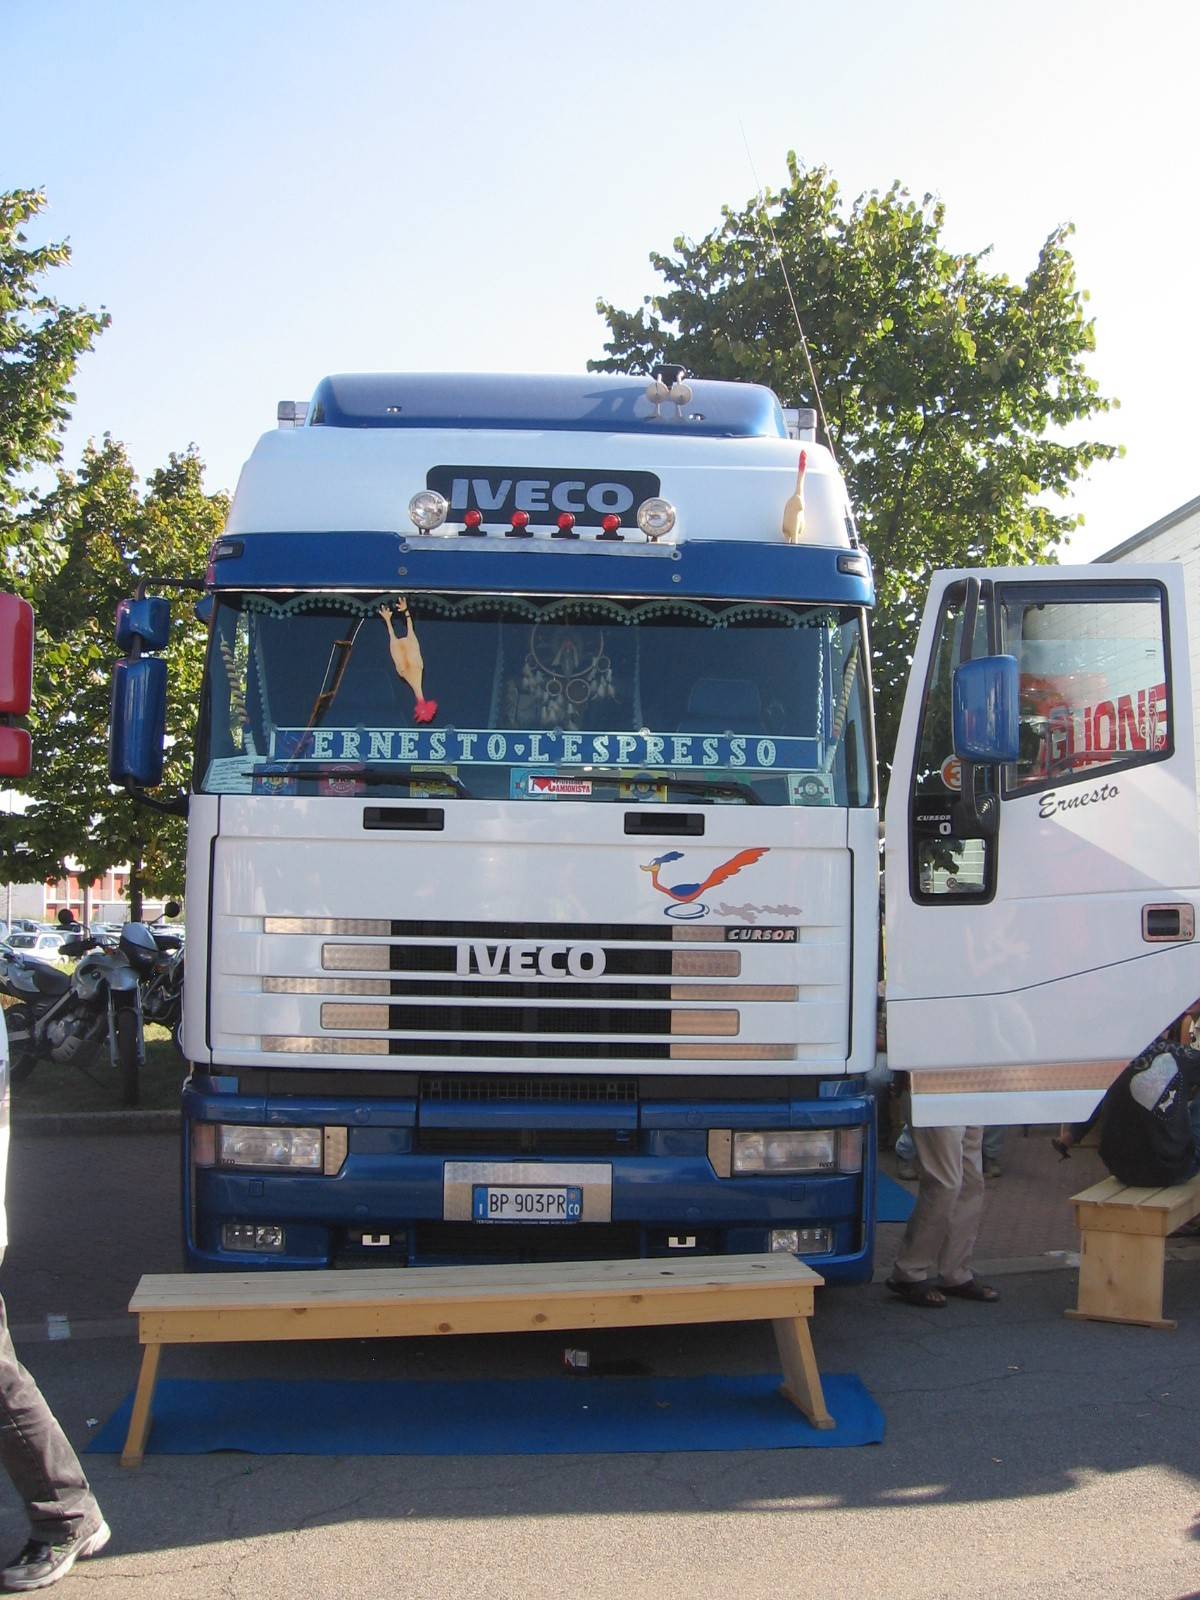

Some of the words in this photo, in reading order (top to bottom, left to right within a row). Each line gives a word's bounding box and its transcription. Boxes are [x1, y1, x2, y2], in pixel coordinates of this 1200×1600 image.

[451, 478, 634, 514] IVECO
[311, 731, 508, 760] ERNESTO
[528, 732, 777, 767] L'ESPRESSO
[916, 814, 952, 822] CURSOR
[1038, 783, 1120, 819] Ernesto
[727, 929, 796, 941] CURSOR
[456, 943, 607, 979] IVECO
[489, 1193, 510, 1213] BP
[514, 1194, 567, 1214] 903PR
[567, 1204, 580, 1216] CO
